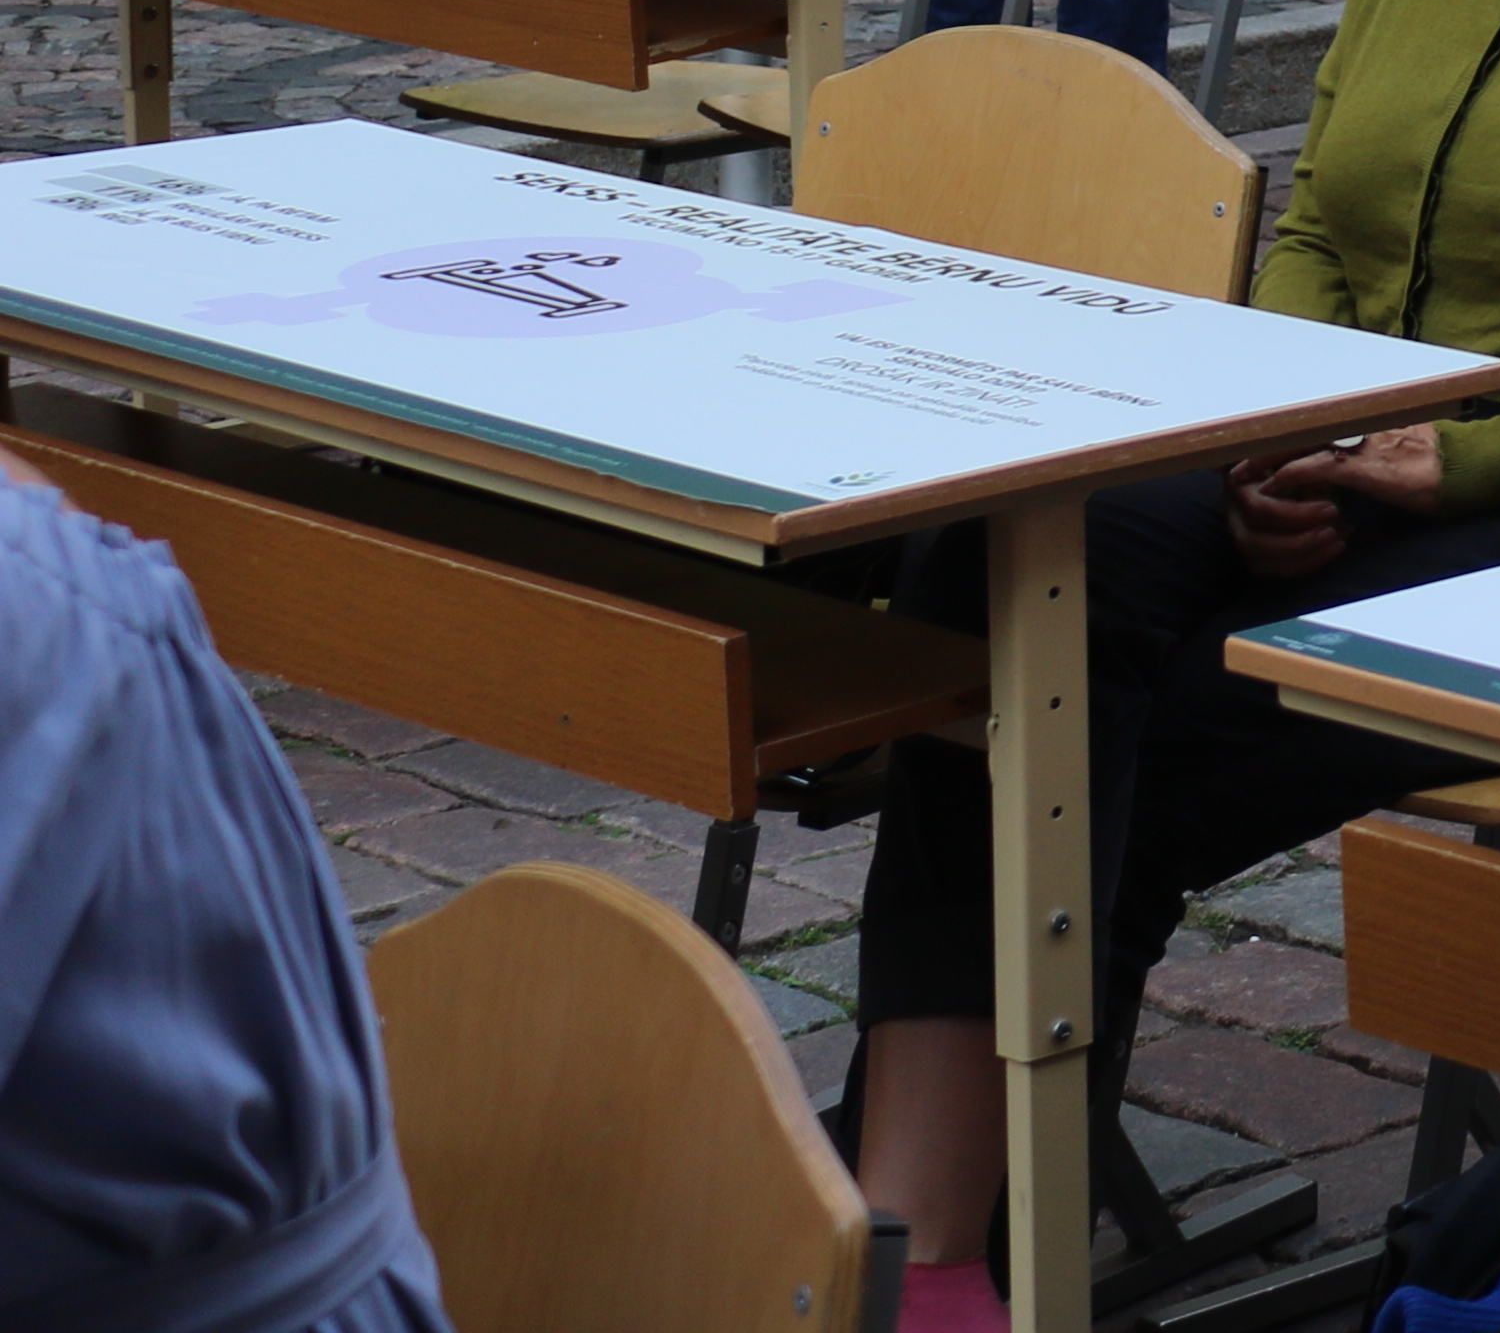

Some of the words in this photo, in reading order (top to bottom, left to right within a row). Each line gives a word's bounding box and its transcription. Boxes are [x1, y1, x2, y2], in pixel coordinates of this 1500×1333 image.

[495, 173, 636, 201] SEKSS
[650, 205, 885, 256] REALITĀTE
[869, 251, 1044, 288] BĒRNU
[1038, 285, 1173, 315] VIDŪ
